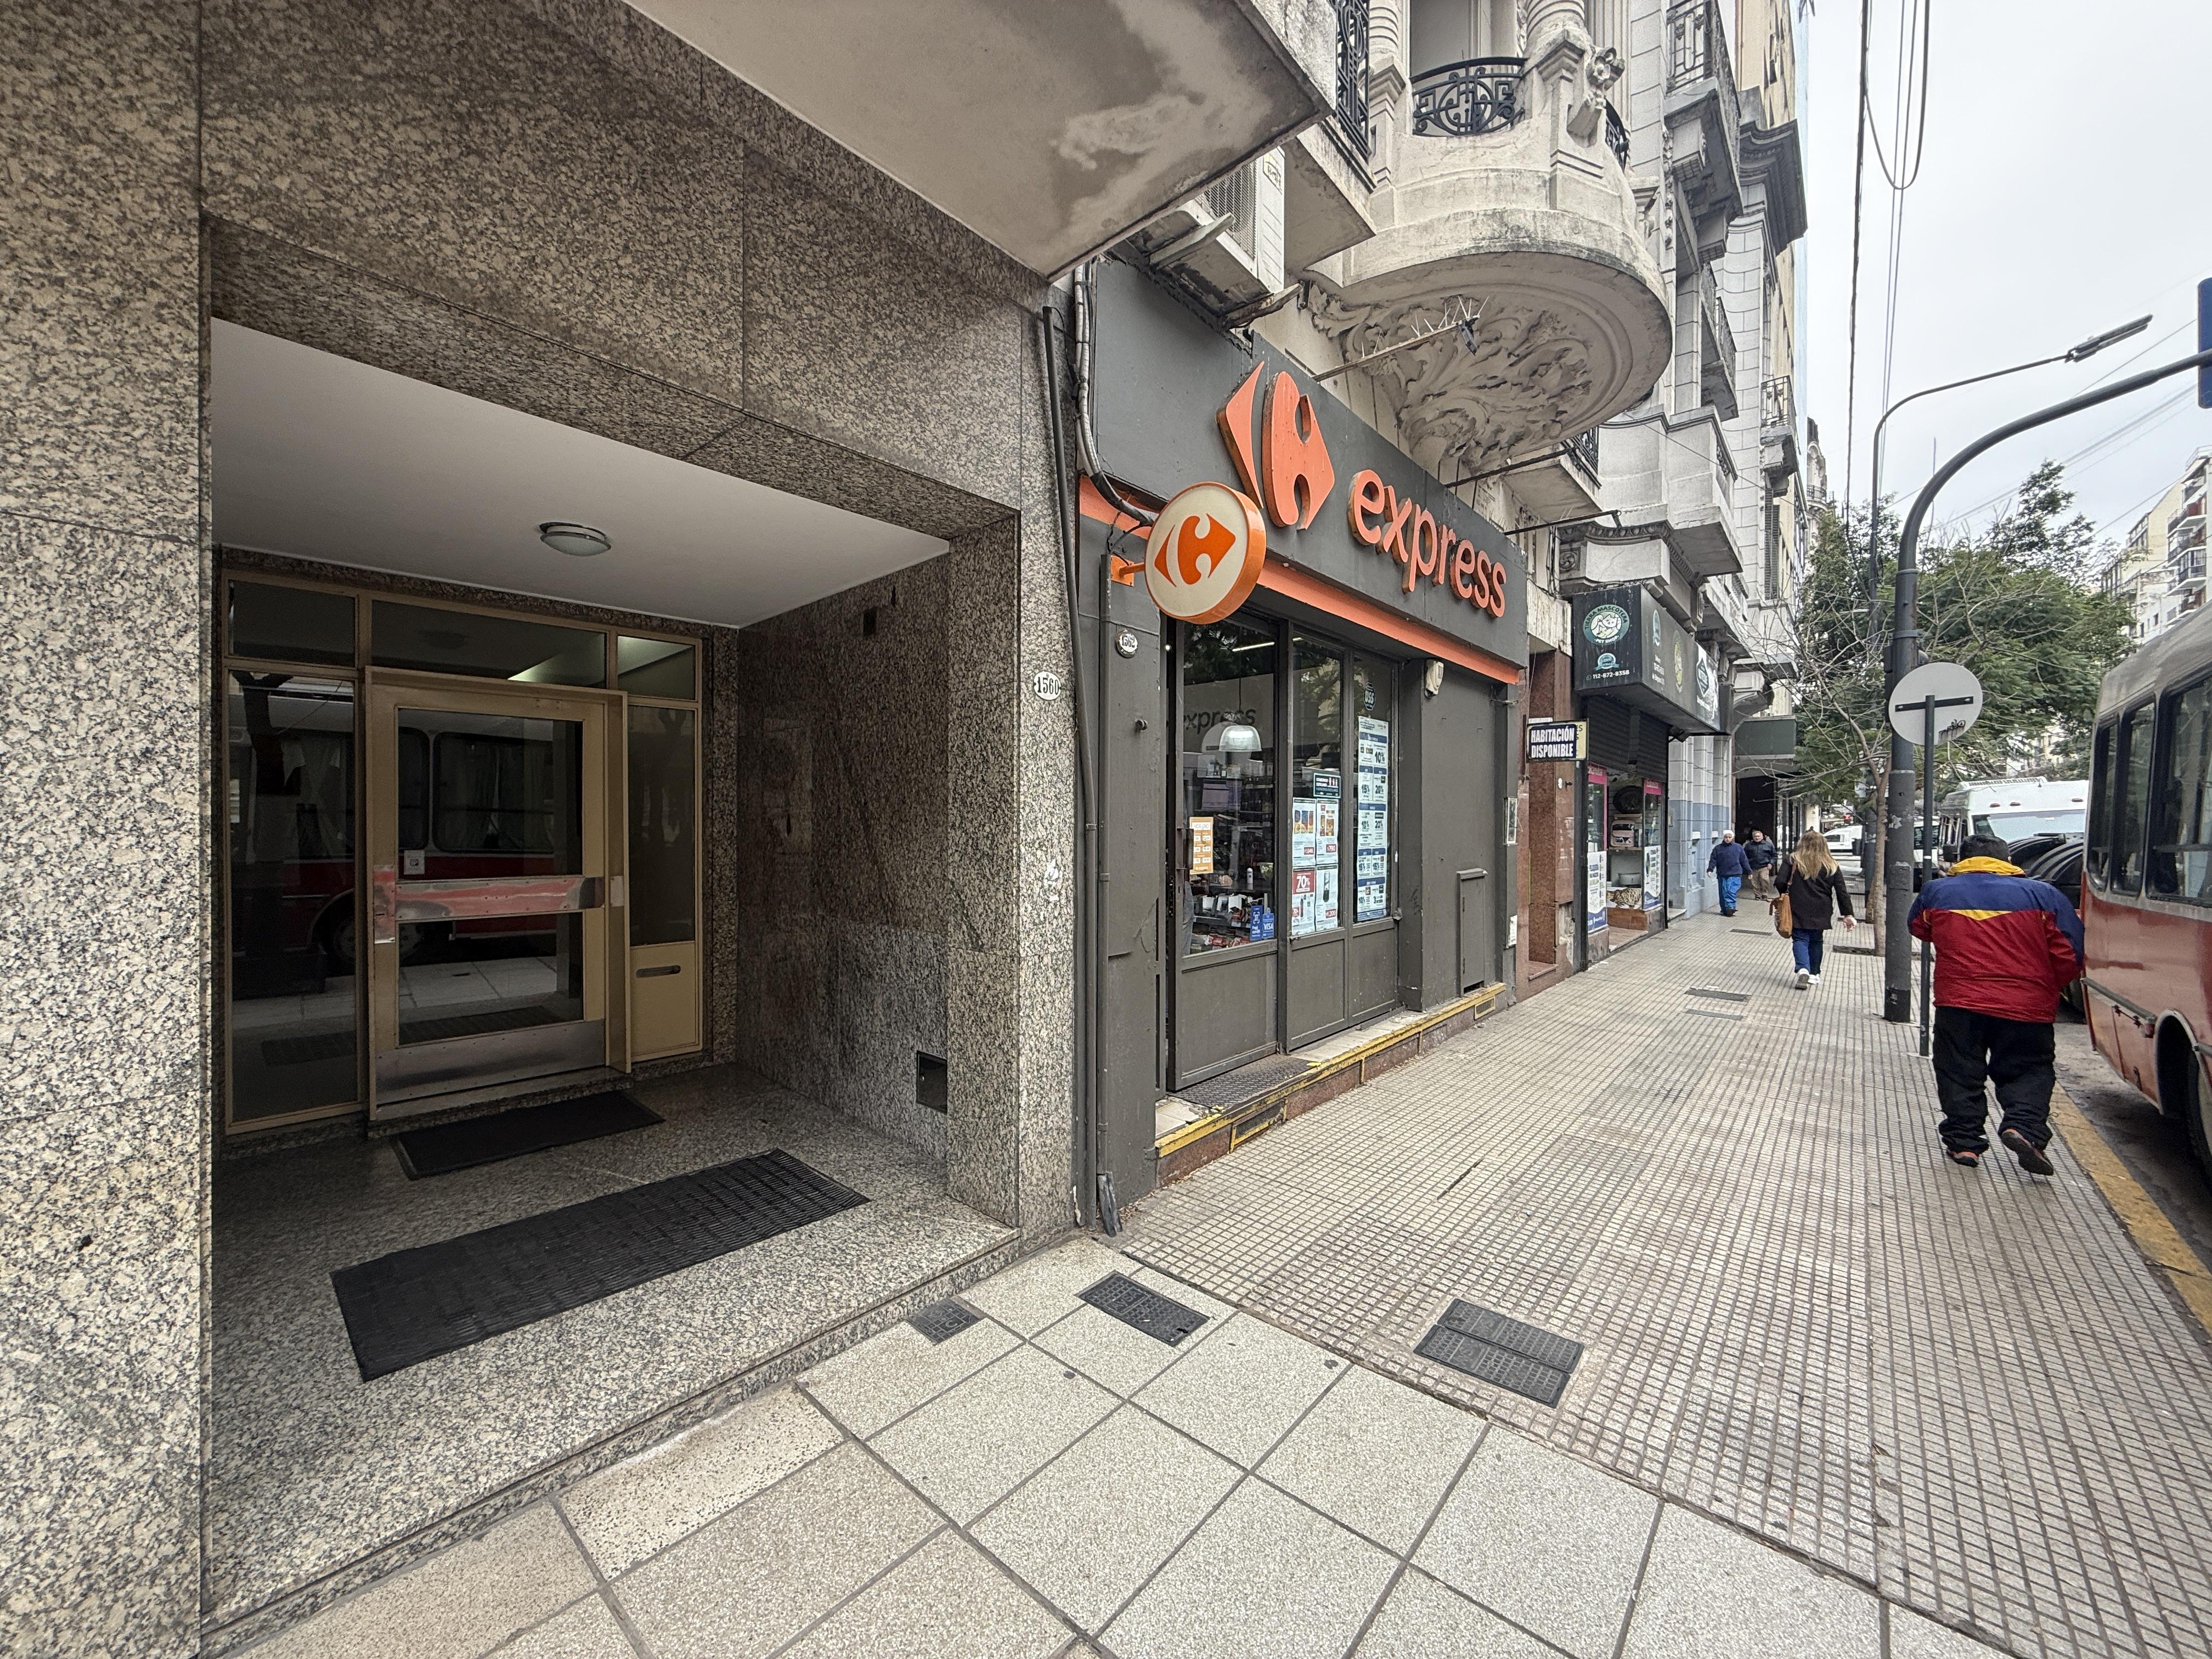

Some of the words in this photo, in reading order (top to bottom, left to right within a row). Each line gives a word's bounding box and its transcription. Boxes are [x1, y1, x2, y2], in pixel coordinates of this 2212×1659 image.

[1348, 470, 1506, 617] express
[1584, 611, 1597, 630] TIERRA
[1597, 606, 1628, 623] MASCOTERA
[1122, 635, 1135, 648] 1562
[1037, 676, 1059, 695] 1560
[1364, 690, 1375, 704] USS
[1183, 709, 1256, 734] xpress
[1531, 726, 1575, 743] HABITACIÓN
[1374, 751, 1386, 764] 10%
[1531, 743, 1573, 758] DISPONIBLE
[1296, 875, 1311, 889] 70%
[1263, 922, 1273, 930] VISA
